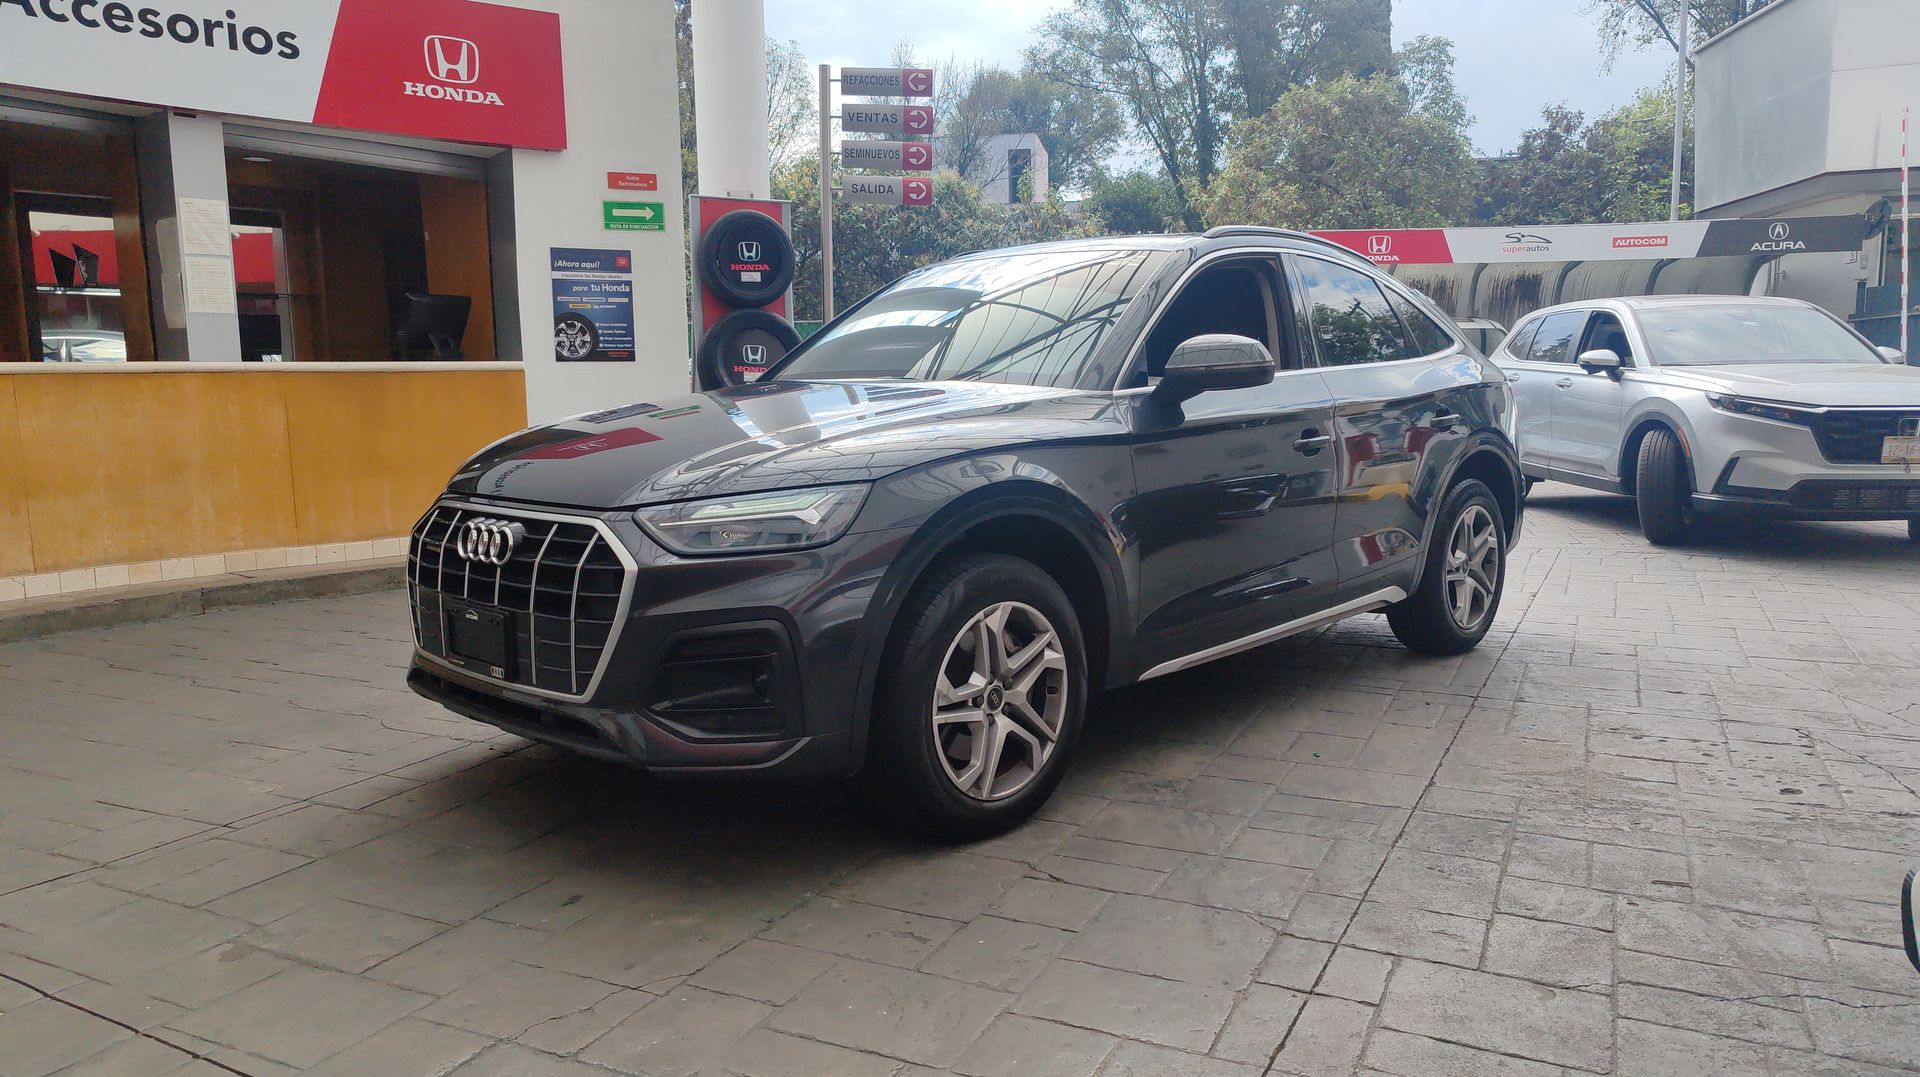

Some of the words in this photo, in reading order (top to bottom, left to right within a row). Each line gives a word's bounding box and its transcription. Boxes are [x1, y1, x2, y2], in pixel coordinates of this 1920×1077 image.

[843, 75, 900, 87] REFACCIONES
[403, 81, 505, 106] HONDA
[848, 112, 898, 124] VENTAS
[844, 148, 900, 160] SEMINUEVOS
[851, 183, 894, 195] SALIDA
[1615, 237, 1666, 247] AUTOCOM
[1750, 240, 1806, 251] ACURA
[1502, 245, 1550, 254] superautos
[554, 260, 580, 268] ¡Ahora
[591, 284, 600, 292] tu
[601, 284, 630, 292] Honda
